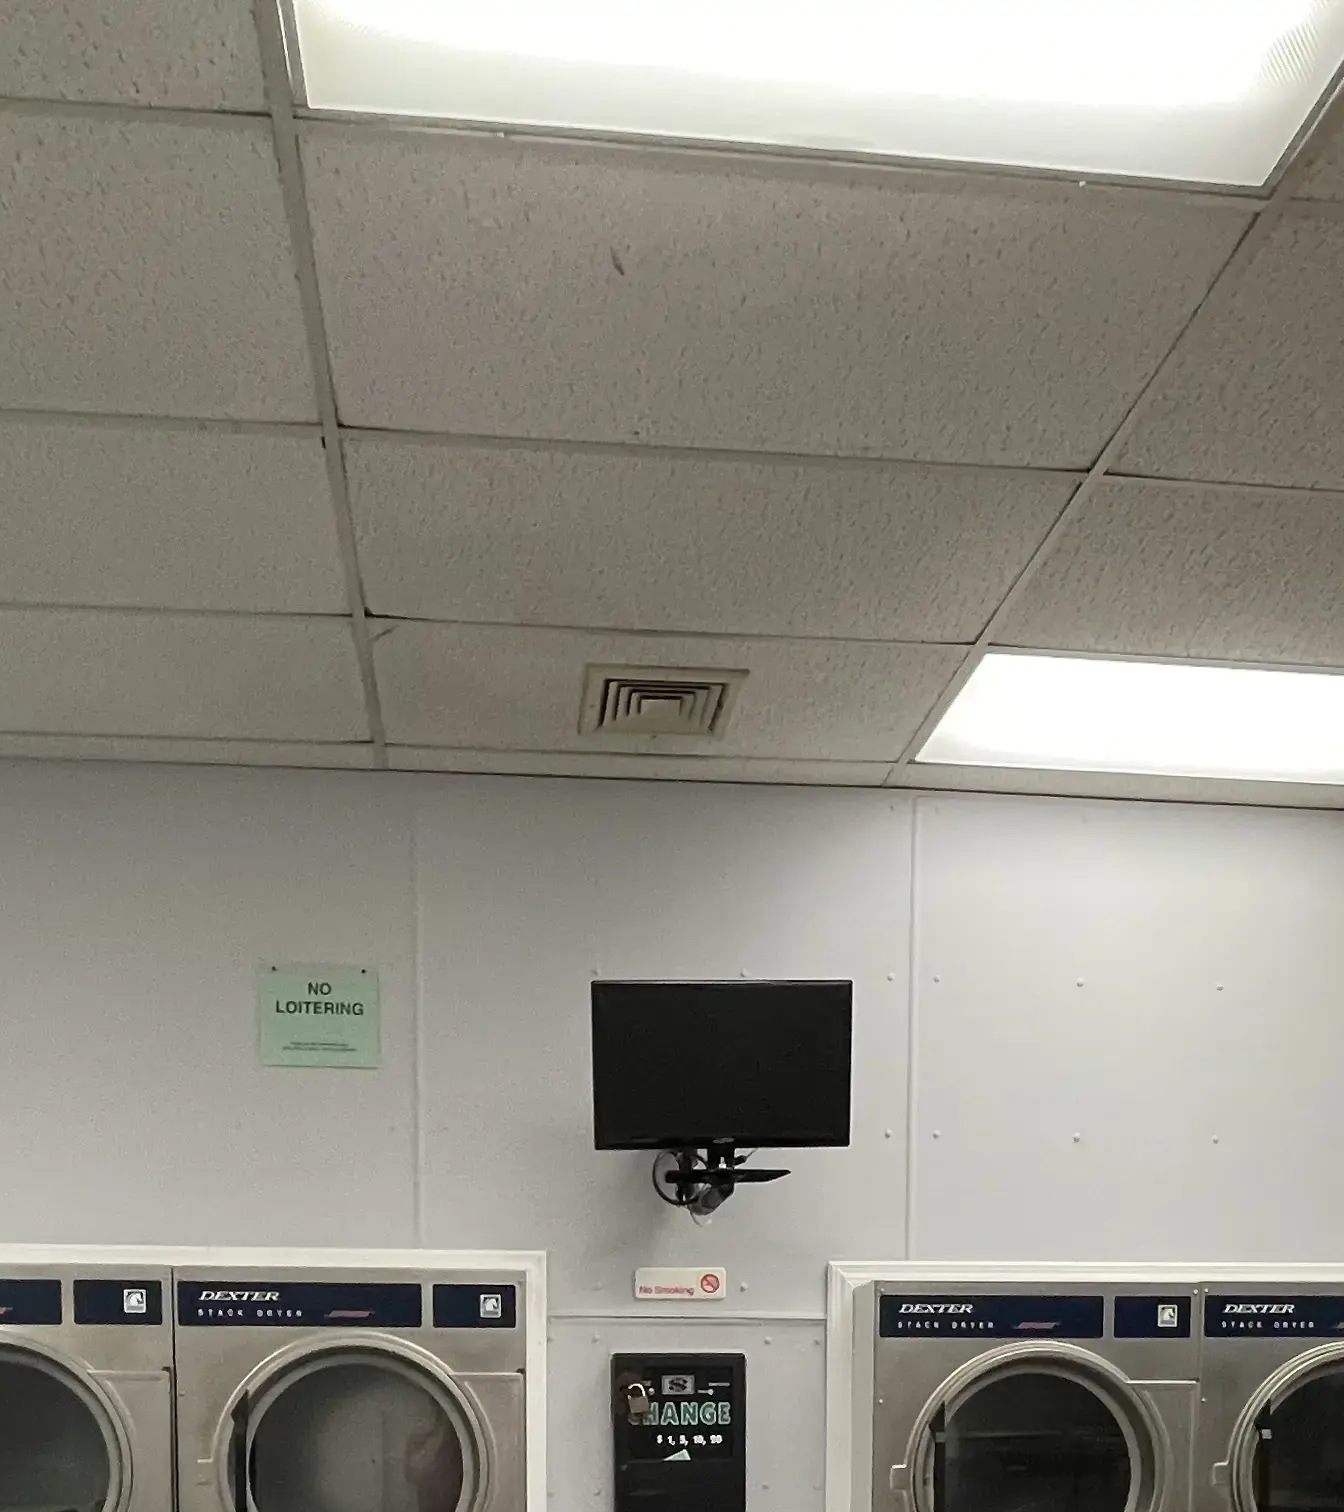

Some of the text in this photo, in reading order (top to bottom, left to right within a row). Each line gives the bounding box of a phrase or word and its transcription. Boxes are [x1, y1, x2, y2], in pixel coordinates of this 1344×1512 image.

[308, 982, 332, 996] NO
[275, 1000, 365, 1016] LOITERING
[198, 1290, 280, 1301] DEXTER
[639, 1285, 695, 1297] No Smoking
[898, 1303, 974, 1314] DEXTER
[1222, 1303, 1295, 1314] DEXTER
